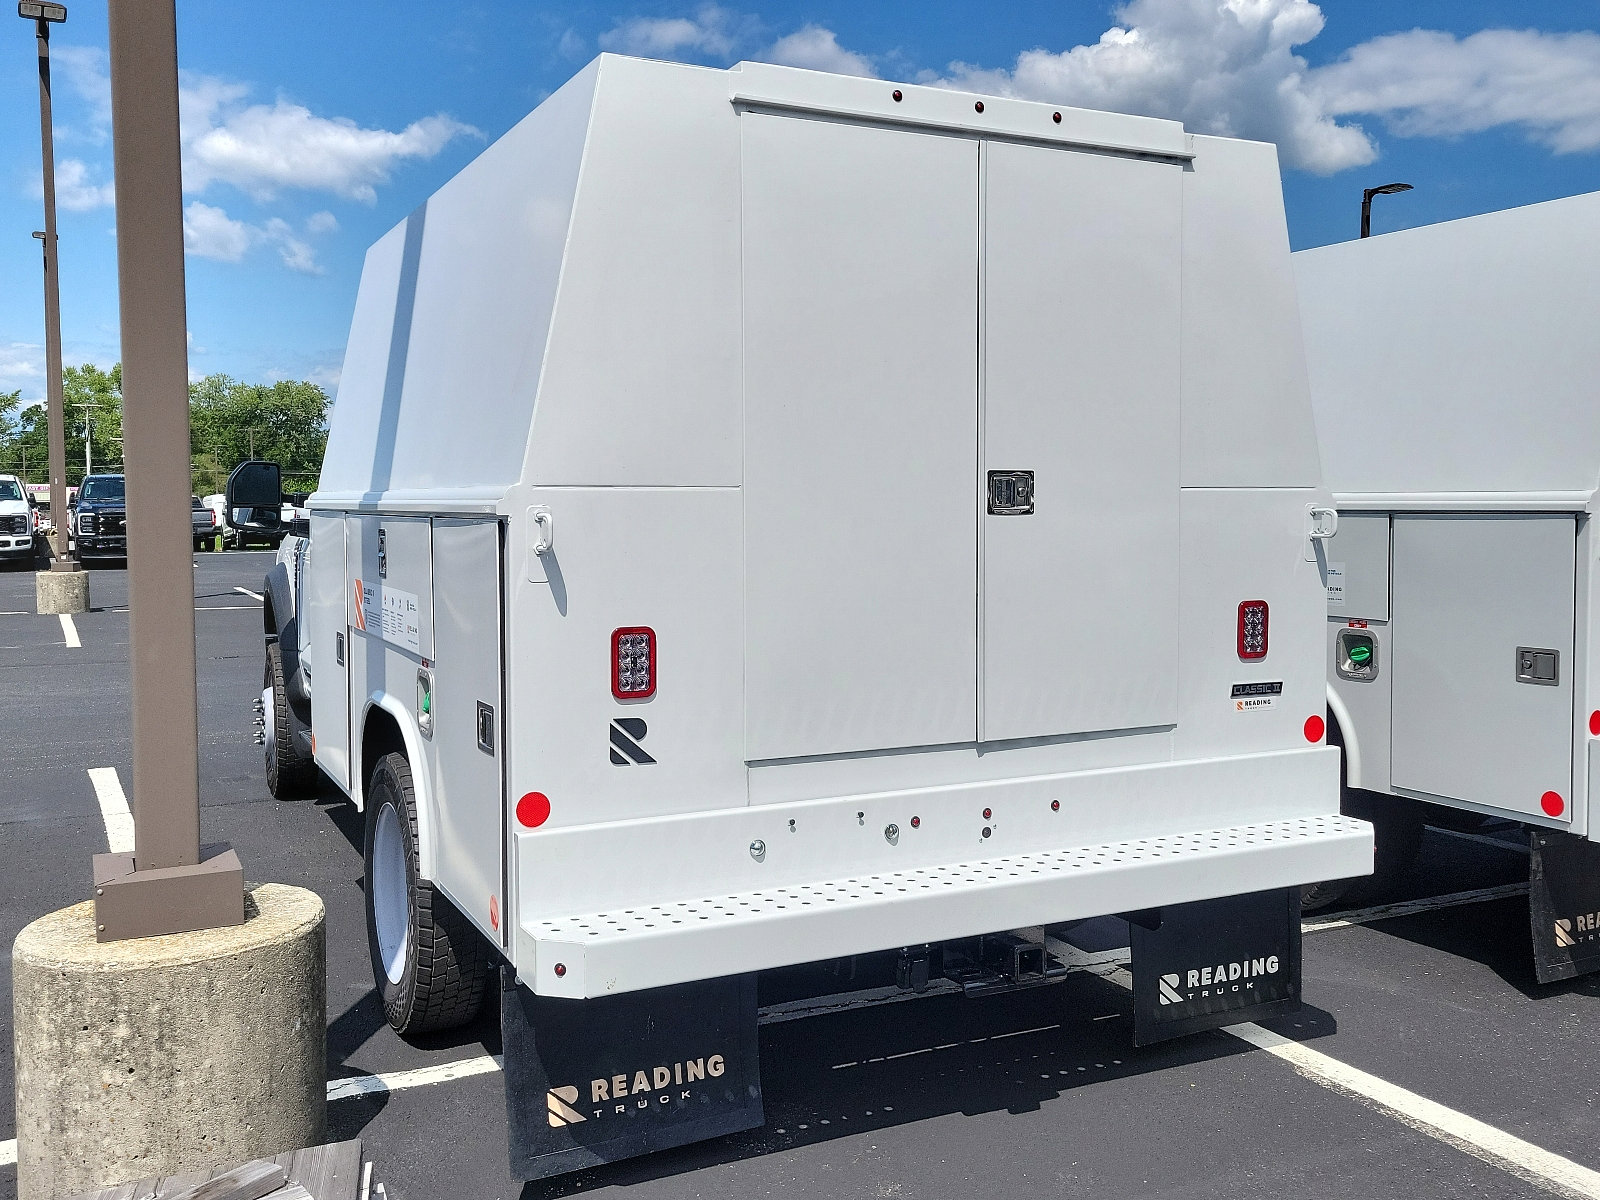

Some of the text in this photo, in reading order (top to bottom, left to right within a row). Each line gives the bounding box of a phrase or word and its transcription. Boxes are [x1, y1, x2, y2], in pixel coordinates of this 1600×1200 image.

[1233, 684, 1271, 695] CLASSIC
[1187, 955, 1279, 989] READING
[1187, 982, 1254, 1000] TRUCK
[591, 1054, 725, 1103] READING
[593, 1089, 691, 1119] TRUCK
